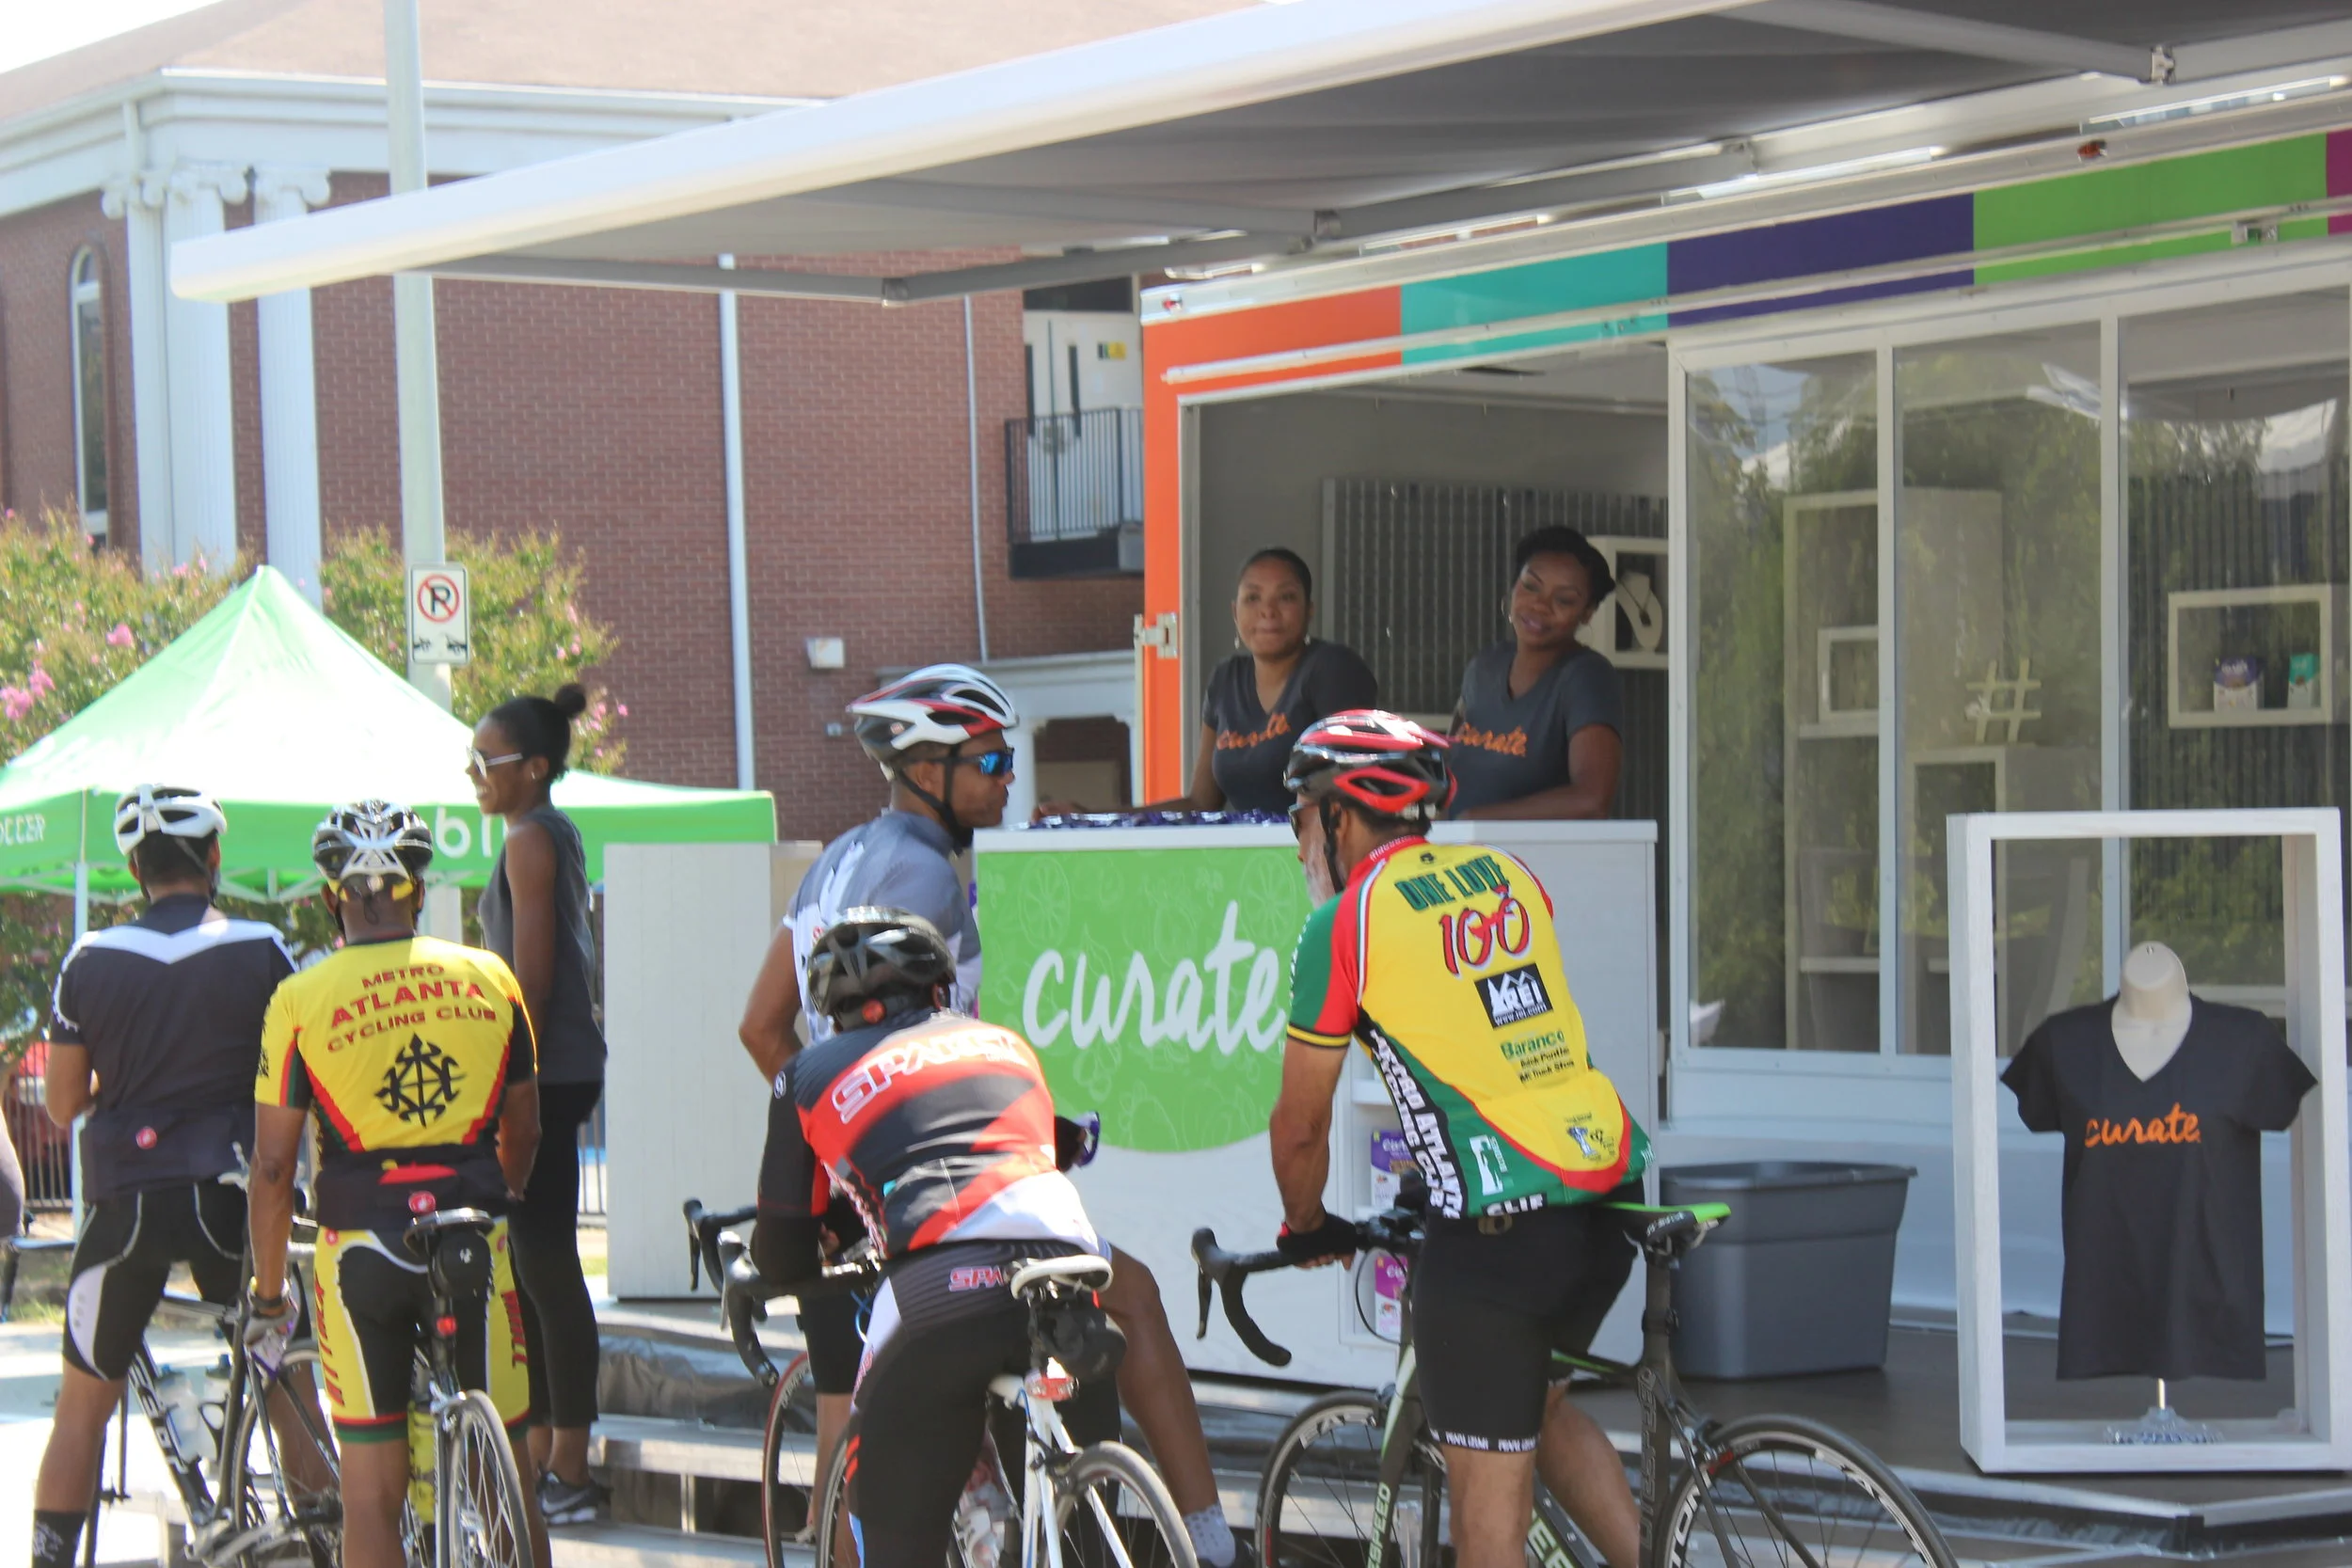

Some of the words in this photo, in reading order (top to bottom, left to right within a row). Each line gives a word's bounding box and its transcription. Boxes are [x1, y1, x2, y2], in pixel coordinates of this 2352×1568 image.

[0, 814, 45, 846] CCER
[1394, 873, 1455, 911] ONE
[1443, 855, 1510, 897] LOVE
[1438, 897, 1532, 978] 100
[362, 963, 444, 989] METRO
[1023, 899, 1287, 1056] curate
[332, 980, 485, 1028] ATLANTA
[327, 1011, 425, 1053] CYCLING
[436, 1006, 497, 1022] CLUB
[2085, 1101, 2201, 1148] curate
[1486, 1194, 1543, 1216] CLIF
